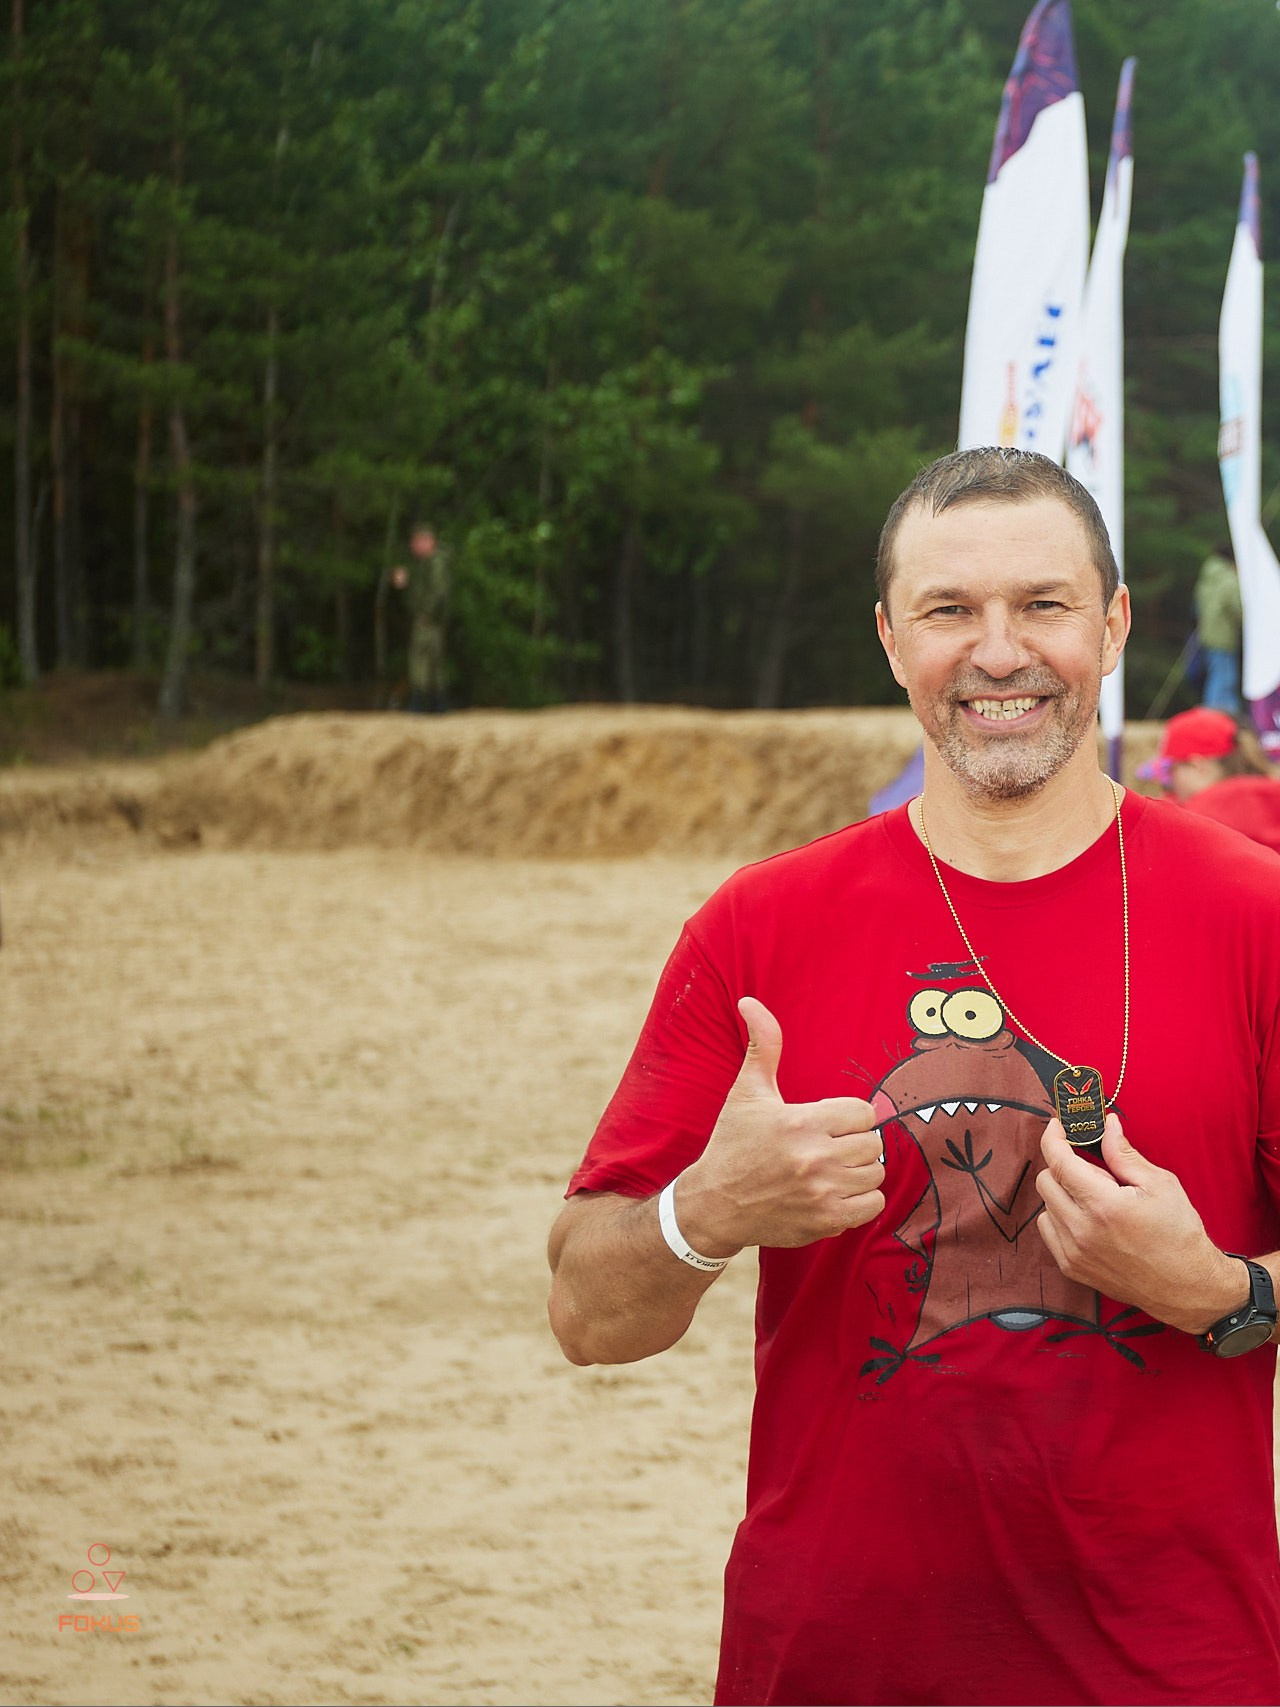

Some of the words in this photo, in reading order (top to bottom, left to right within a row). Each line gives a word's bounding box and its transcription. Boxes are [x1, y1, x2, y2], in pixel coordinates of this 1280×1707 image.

[1068, 1096, 1092, 1104] ГОНКА
[1067, 1105, 1095, 1113] ГЕРОЕВ
[1070, 1120, 1097, 1132] 2025
